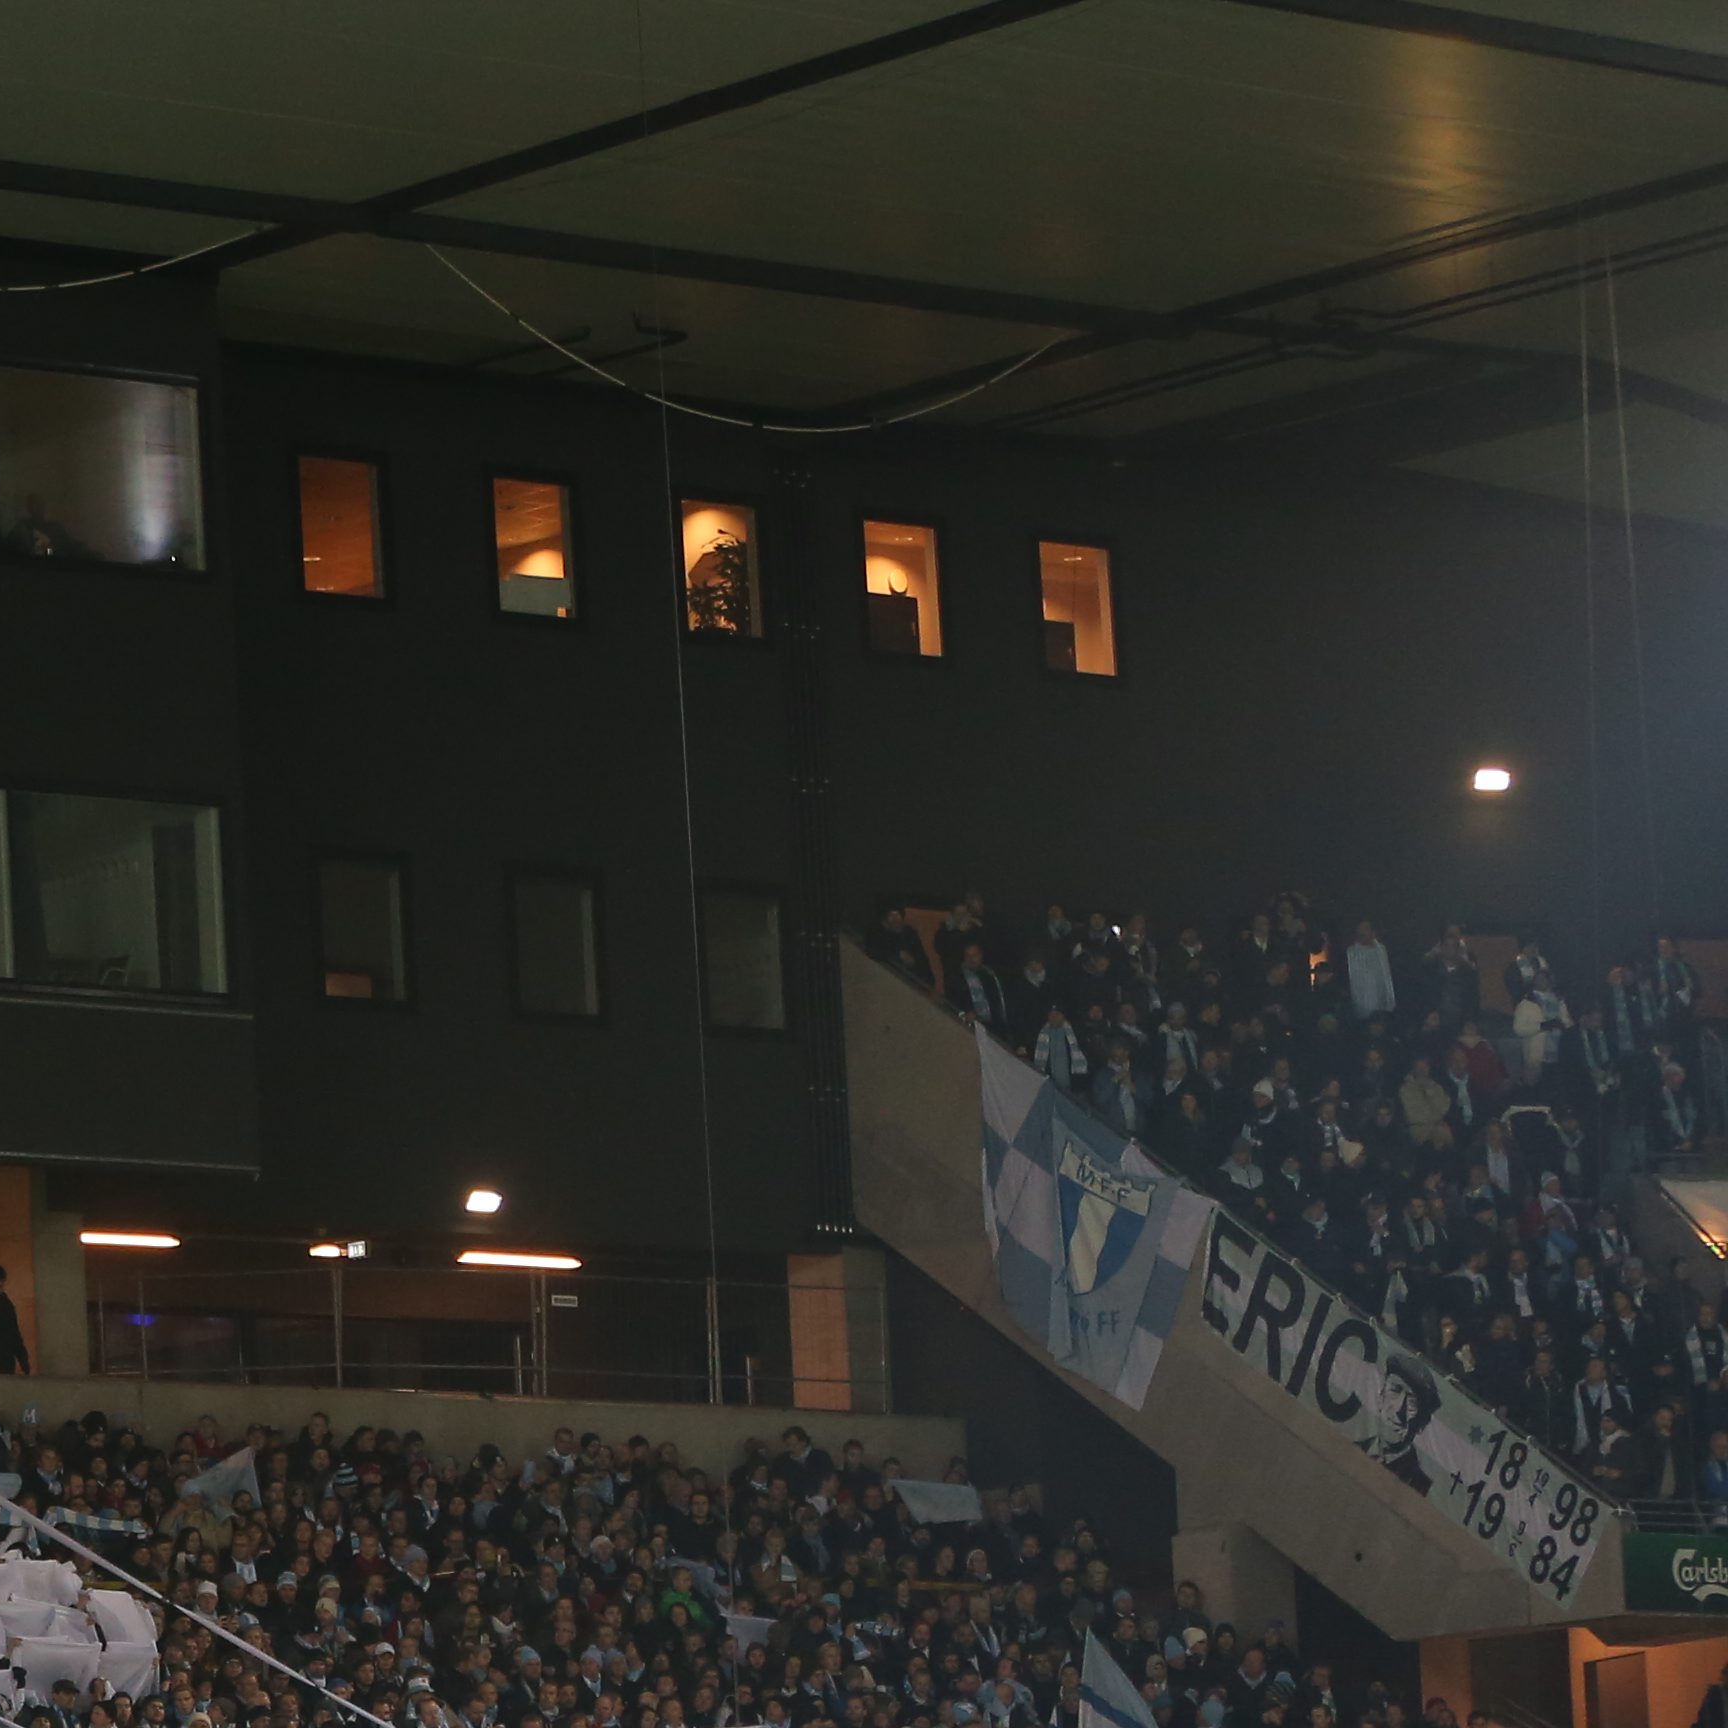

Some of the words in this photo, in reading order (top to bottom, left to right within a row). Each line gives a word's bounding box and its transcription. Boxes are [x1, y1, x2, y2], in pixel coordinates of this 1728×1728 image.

[1201, 1206, 1379, 1423] ERIC
[1462, 1479, 1507, 1540] 19
[1528, 1535, 1581, 1601] 84
[1484, 1429, 1529, 1491] 18
[1548, 1482, 1600, 1547] 98
